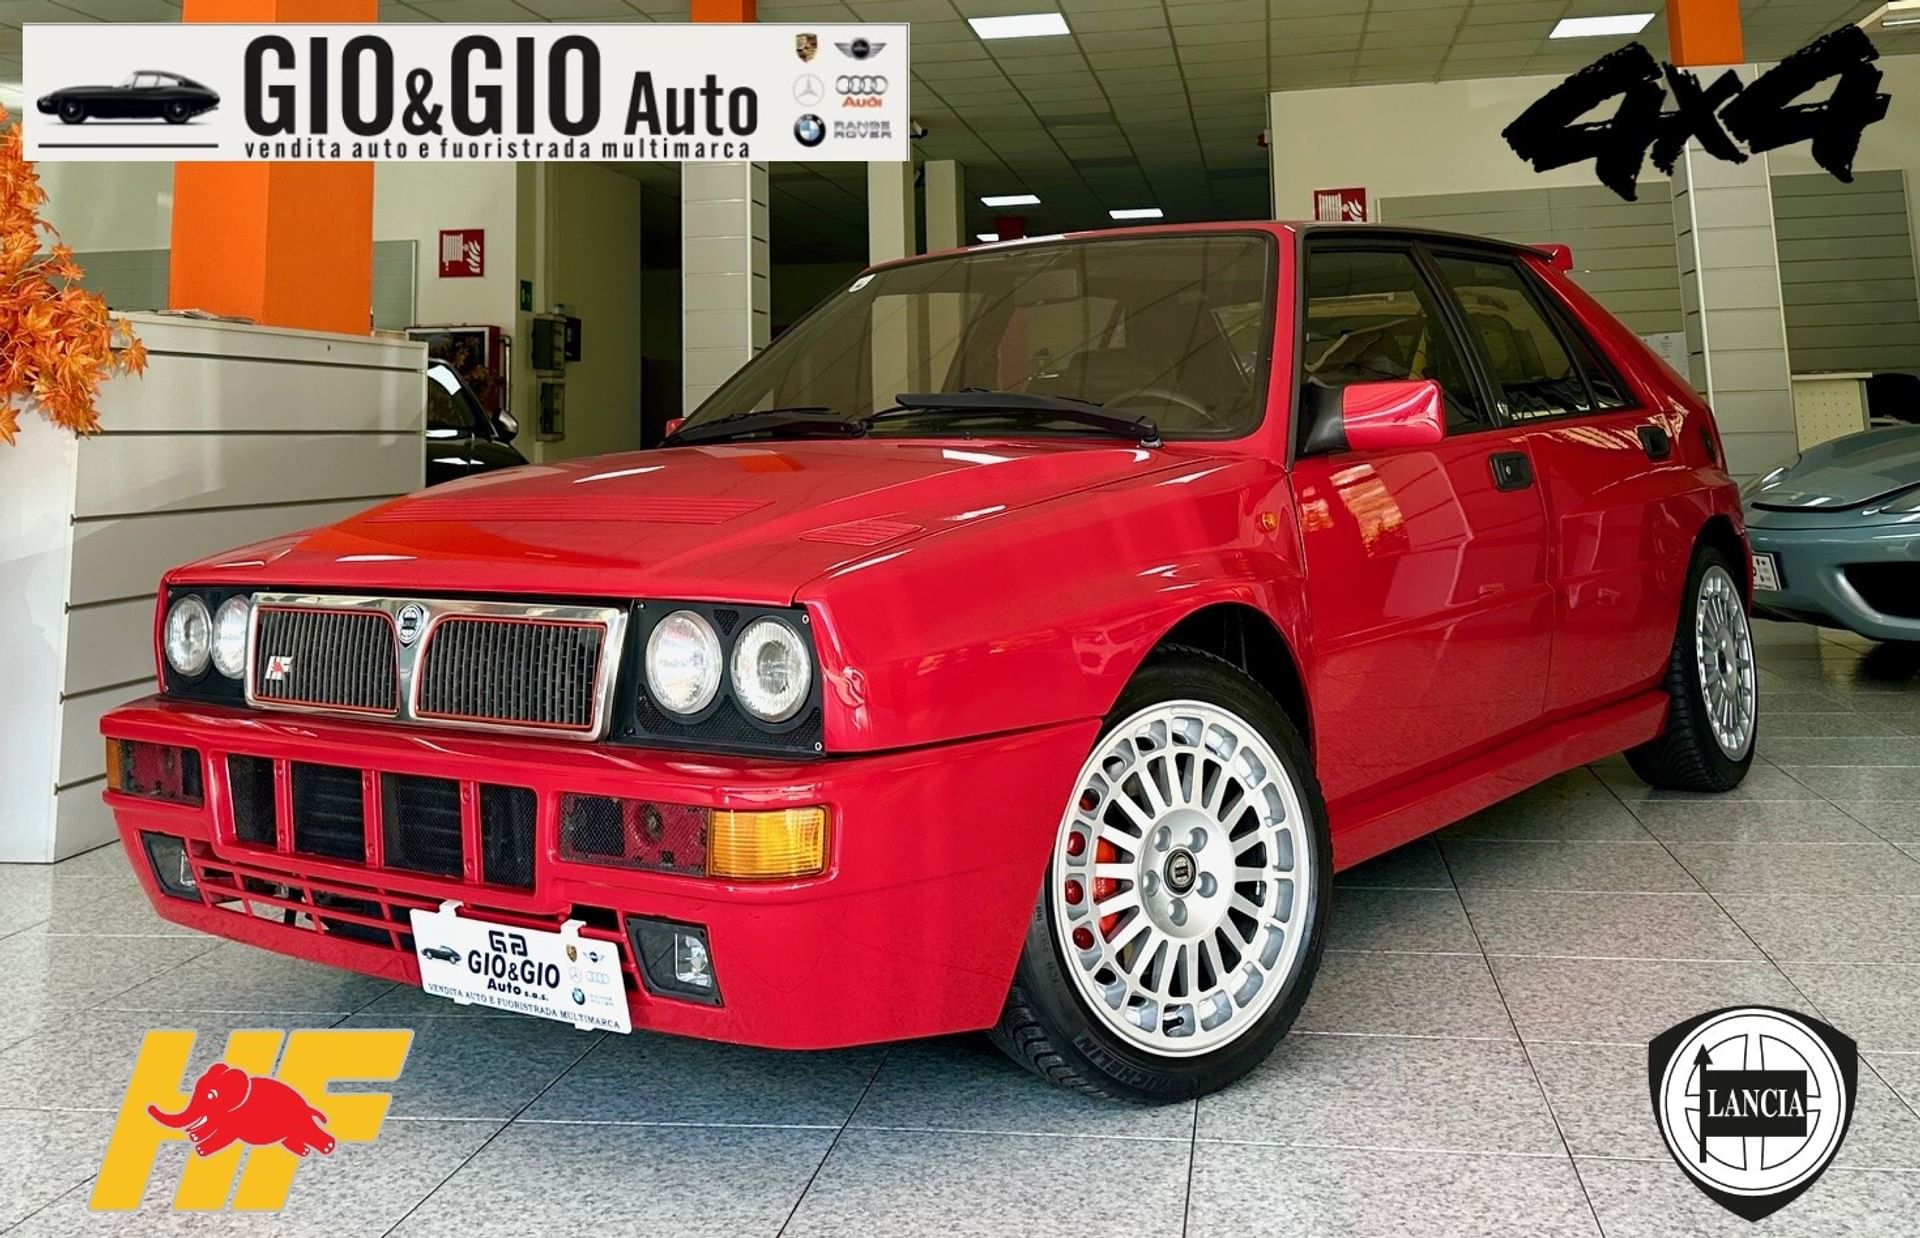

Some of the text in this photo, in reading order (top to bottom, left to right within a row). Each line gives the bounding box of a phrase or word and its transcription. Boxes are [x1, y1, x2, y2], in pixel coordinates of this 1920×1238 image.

[468, 949, 560, 989] GIO&GIO
[487, 977, 521, 996] Auto
[428, 983, 620, 1029] VENDITA AUTO E FUORISTRADA MULTIMARCA
